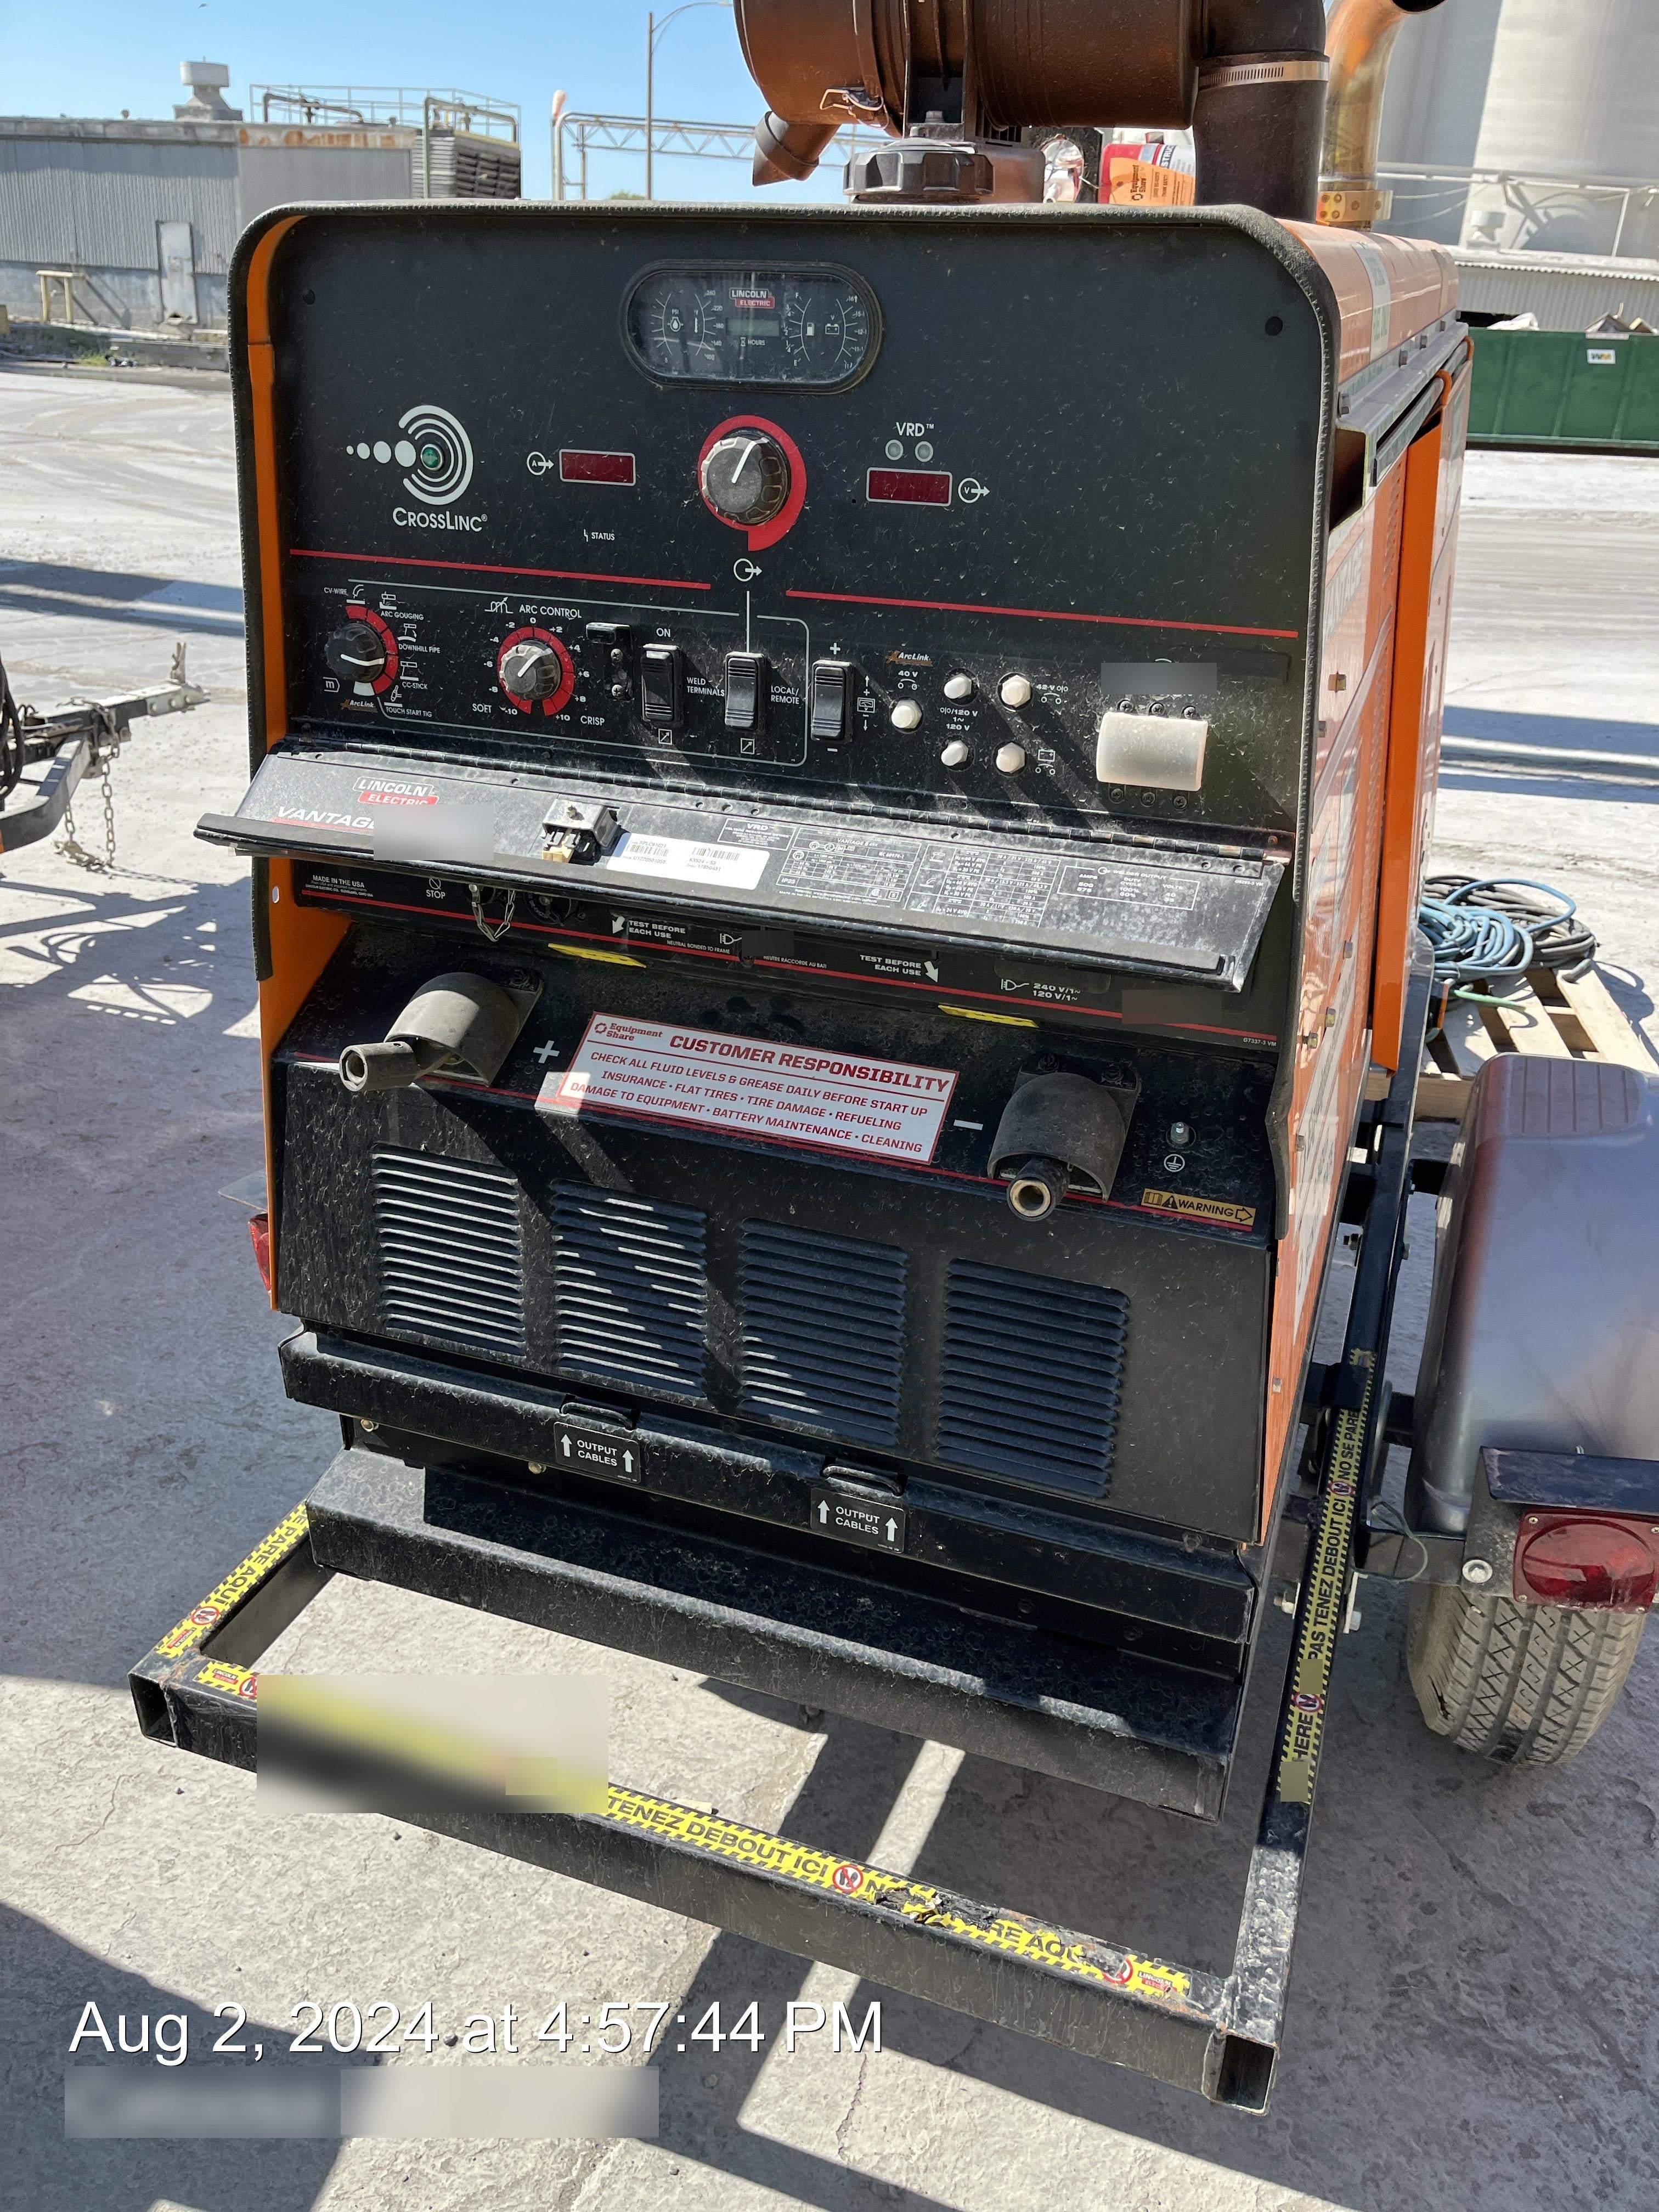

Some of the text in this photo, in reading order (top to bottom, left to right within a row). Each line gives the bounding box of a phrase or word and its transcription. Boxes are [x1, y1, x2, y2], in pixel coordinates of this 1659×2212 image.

[591, 532, 615, 540] STATUS
[520, 605, 582, 618] ARC CONTROL
[656, 628, 671, 637] ON
[899, 652, 931, 661] ArcLink
[687, 677, 706, 686] WELD
[687, 686, 725, 697] TERMINALS
[771, 686, 799, 697] LOCAL/
[771, 695, 800, 704] REMOTE
[580, 716, 605, 726] CRISP
[358, 780, 428, 796] LINCOLN
[426, 889, 445, 899] STOP
[629, 928, 653, 937] EACH
[652, 924, 686, 934] BEFORE
[667, 940, 686, 948] NEUTRAL
[687, 943, 706, 951] BONDED
[860, 955, 922, 968] TEST BEFORE
[875, 964, 921, 976] EACH USE
[1033, 982, 1056, 992] 240
[1032, 990, 1053, 999] 120
[606, 1031, 635, 1041] Share
[609, 1023, 663, 1039] Equipment
[669, 1035, 949, 1092] CUSTOMER RESPONSIBILITY
[590, 1052, 928, 1116] CHECK ALL FLUID LEVELS & GREASE DAILY BEFORE START UP
[601, 1071, 902, 1131] INSURANCE FLAT TIRES TIRE DAMAGE REFUELING
[570, 1082, 923, 1153] DAMAGE TO EQUIPMENT BATTERY MAINTENANCE CLEANING
[1178, 1199, 1234, 1217] WARNING
[577, 1439, 618, 1455] OUTPUT
[1339, 1412, 1359, 1480] NO SE PARE
[577, 1450, 618, 1467] CABLES
[1332, 1499, 1346, 1516] ICI
[835, 1506, 880, 1523] OUTPUT
[835, 1516, 879, 1534] CABLES
[252, 1525, 299, 1566] PARE
[1322, 1518, 1342, 1576] DEBOUT
[1314, 1579, 1333, 1627] TENEZ
[608, 1796, 828, 1876] TENEZ DEBOUT ICI
